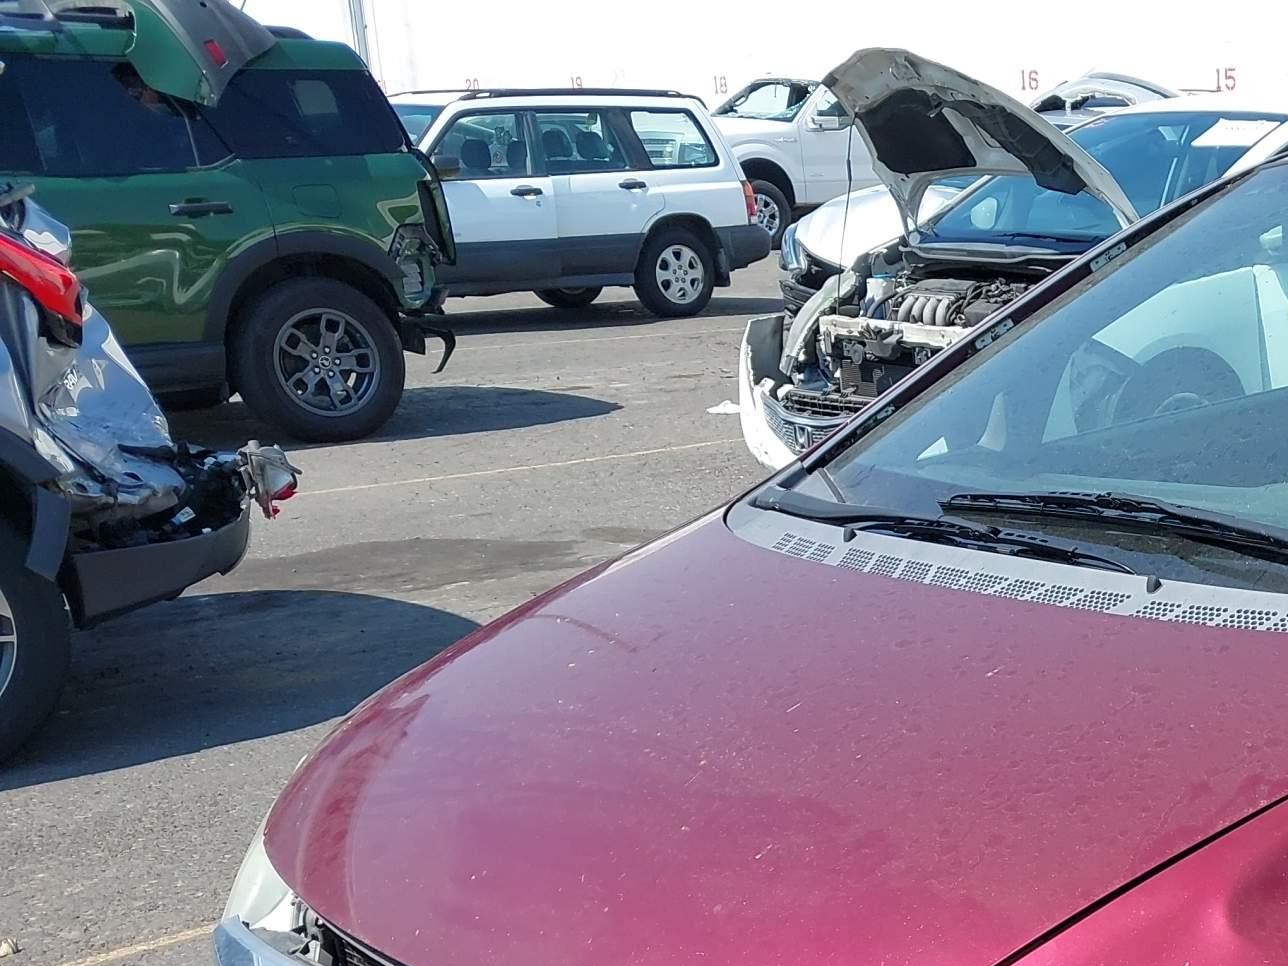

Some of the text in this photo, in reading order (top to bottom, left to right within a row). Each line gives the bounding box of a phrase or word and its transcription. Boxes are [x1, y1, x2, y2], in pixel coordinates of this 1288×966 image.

[713, 75, 728, 95] 18
[1021, 69, 1039, 91] 16
[1215, 67, 1236, 92] 15
